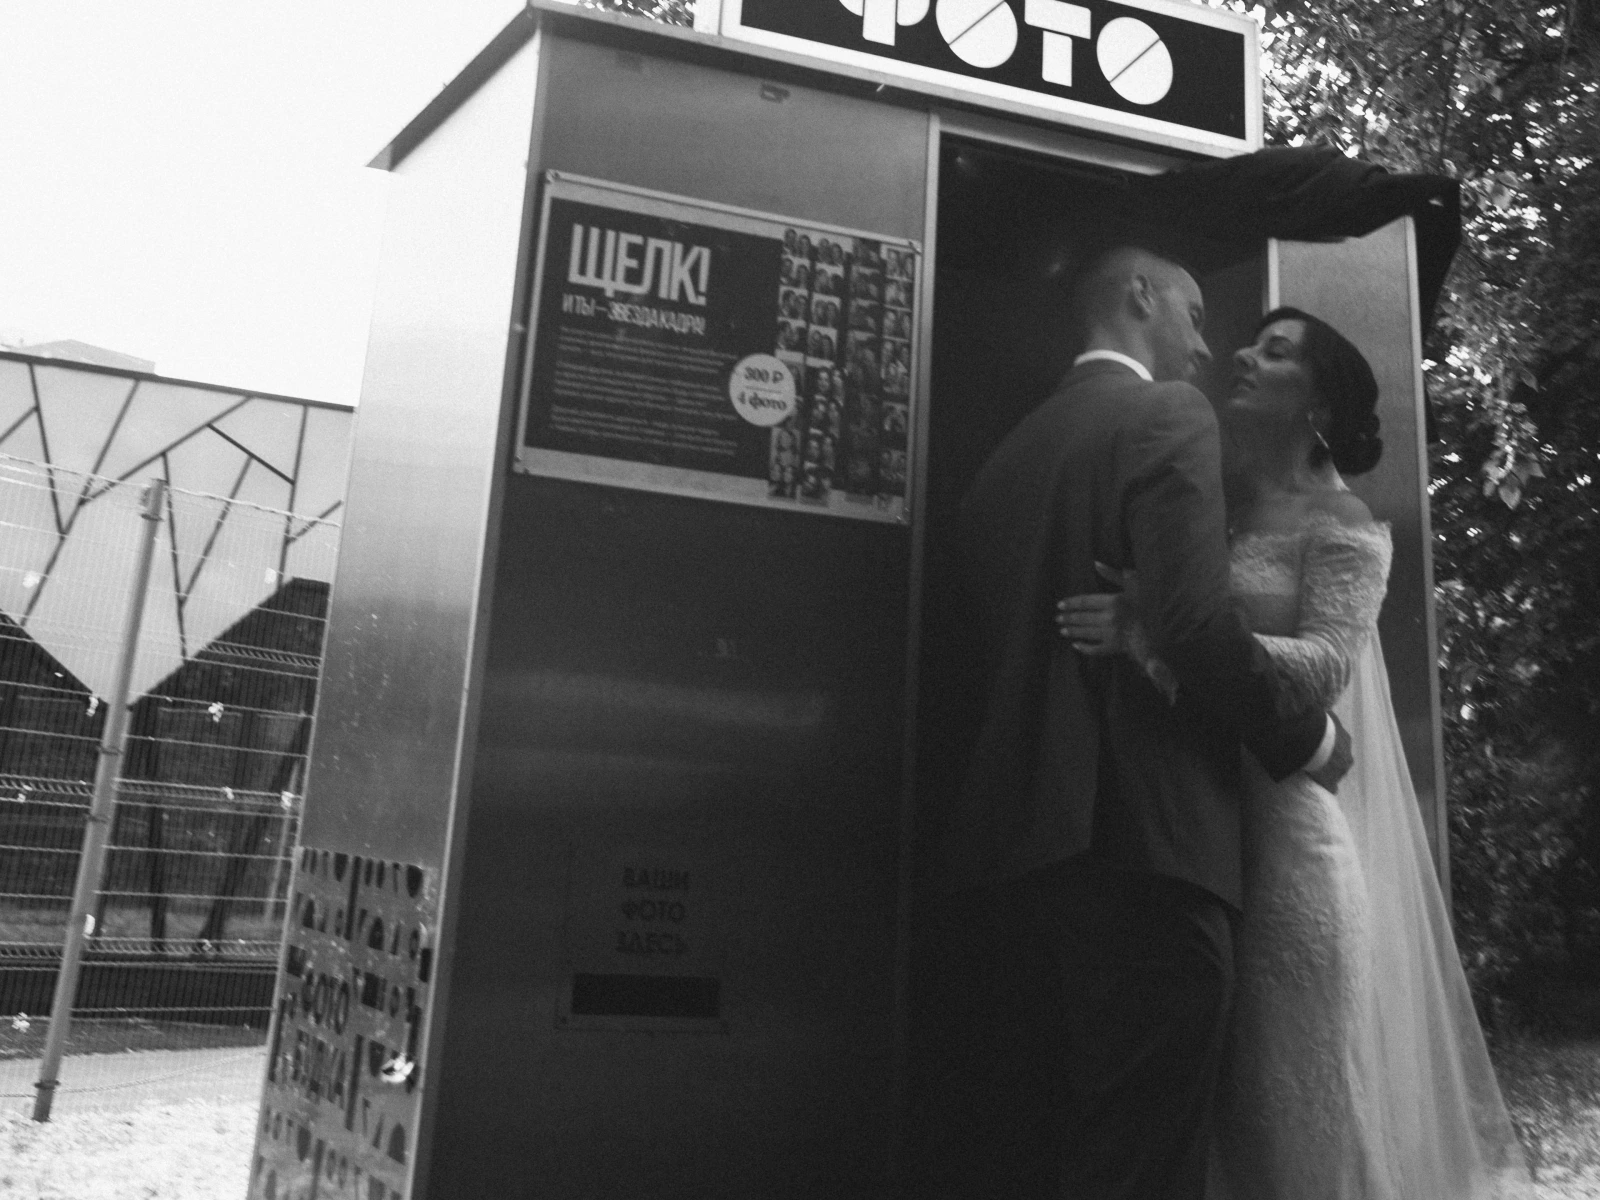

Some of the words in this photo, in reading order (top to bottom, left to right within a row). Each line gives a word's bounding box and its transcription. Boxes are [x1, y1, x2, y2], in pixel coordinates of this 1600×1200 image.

[567, 223, 711, 305] ЩЕЛК!
[748, 391, 789, 412] фото
[622, 866, 690, 891] ВАШИ
[620, 898, 687, 924] ФОТО
